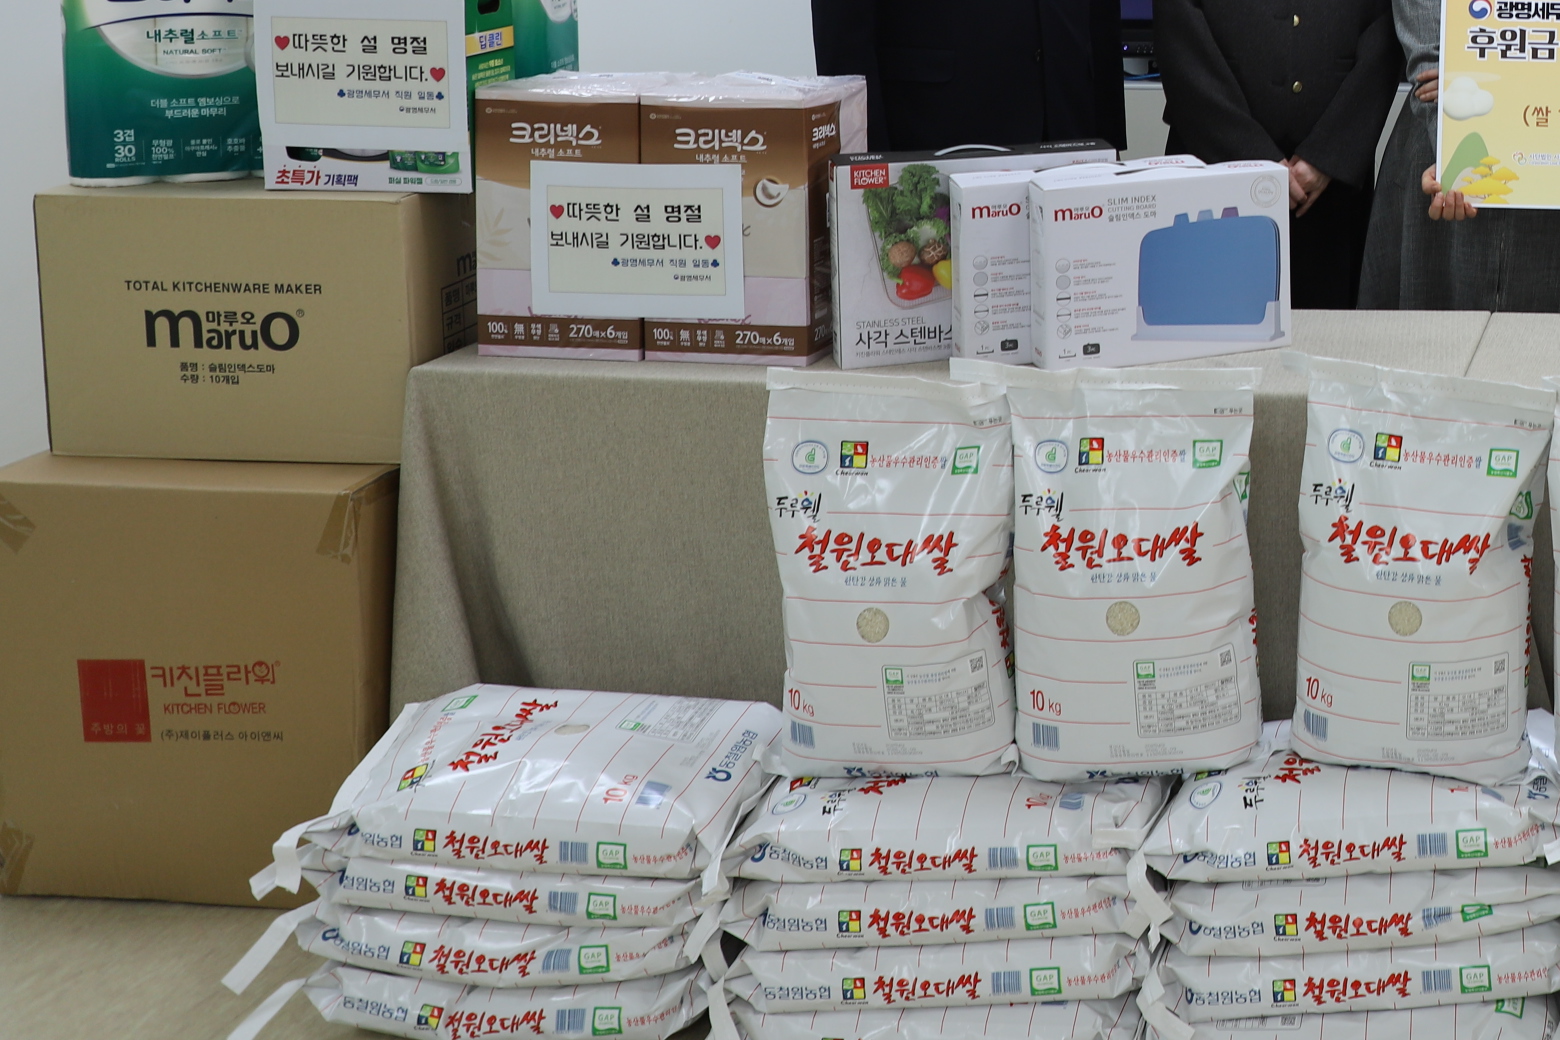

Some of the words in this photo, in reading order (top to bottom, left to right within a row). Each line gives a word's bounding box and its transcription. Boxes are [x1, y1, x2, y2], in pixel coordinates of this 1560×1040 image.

[163, 48, 198, 56] NATURAL
[292, 33, 348, 53] 따뜻한
[360, 35, 378, 54] 설
[391, 36, 428, 55] 명절
[1467, 28, 1559, 61] 후원금
[275, 62, 336, 80] 보내시길
[346, 64, 428, 82] 기원합니다.
[151, 98, 167, 107] 더블
[170, 98, 196, 107] 소프트
[198, 96, 240, 107] 엠보싱으로
[346, 89, 390, 99] 광명세무서
[395, 90, 412, 100] 직원
[418, 90, 435, 100] 일동
[165, 110, 199, 119] 부드러운
[201, 107, 227, 117] 마무리
[1523, 107, 1551, 129] (쌀
[113, 129, 135, 142] 3겹
[509, 122, 602, 146] 크리넥스
[674, 128, 767, 152] 크리넥스
[114, 145, 136, 157] 30
[275, 168, 322, 186] 초특가
[323, 174, 359, 187] 기획팩
[853, 169, 886, 178] KITCHEN
[854, 177, 884, 186] FLOWER
[1107, 197, 1129, 206] SLIM
[1131, 195, 1156, 204] INDEX
[1108, 205, 1132, 213] CUTTING
[567, 203, 620, 221] 따뜻한
[634, 204, 650, 222] 설
[664, 204, 702, 222] 명절
[550, 231, 609, 249] 보내시길
[620, 233, 703, 250] 기원합니다.
[125, 280, 168, 292] TOTAL
[172, 281, 270, 294] KITCHENWARE
[274, 283, 322, 295] MAKER
[205, 311, 256, 327] 마루오
[855, 318, 899, 330] STAINLESS
[901, 316, 926, 326] STEEL
[855, 329, 890, 350] 사각
[179, 362, 199, 372] 품명
[208, 362, 275, 374] 슬림인덱스도마
[180, 374, 199, 383] 수량
[209, 375, 240, 385] 10개입
[794, 525, 958, 576] 철원오대쌀
[1040, 521, 1204, 571] 철원오대쌀
[1328, 515, 1490, 575] 철원오대쌀
[150, 661, 276, 698] 키친플라워
[1305, 676, 1321, 699] 10
[1320, 691, 1334, 708] kg
[163, 703, 213, 715] KITCHEN
[217, 702, 266, 715] FLOWER
[787, 688, 801, 710] 10
[802, 702, 815, 717] kg
[1030, 689, 1045, 711] 10
[1048, 701, 1062, 716] kg
[91, 722, 128, 735] 주방의
[134, 723, 146, 735] 꽃
[238, 730, 284, 742] 아이앤씨
[769, 845, 828, 870] 동철원농협
[868, 846, 978, 874] 철원오대쌀
[1032, 849, 1050, 857] GAP
[433, 878, 538, 914] 철원오대쌀
[593, 900, 609, 908] GAP
[428, 945, 537, 977] 철원오대쌀
[587, 953, 602, 961] GAP
[764, 985, 832, 1001] 동철원농협
[873, 972, 982, 1001] 철원오대쌀
[1035, 973, 1055, 983] GAP
[343, 996, 408, 1022] 동철원농협
[445, 1009, 546, 1040] 철원오대쌀
[597, 1014, 615, 1022] GAP
